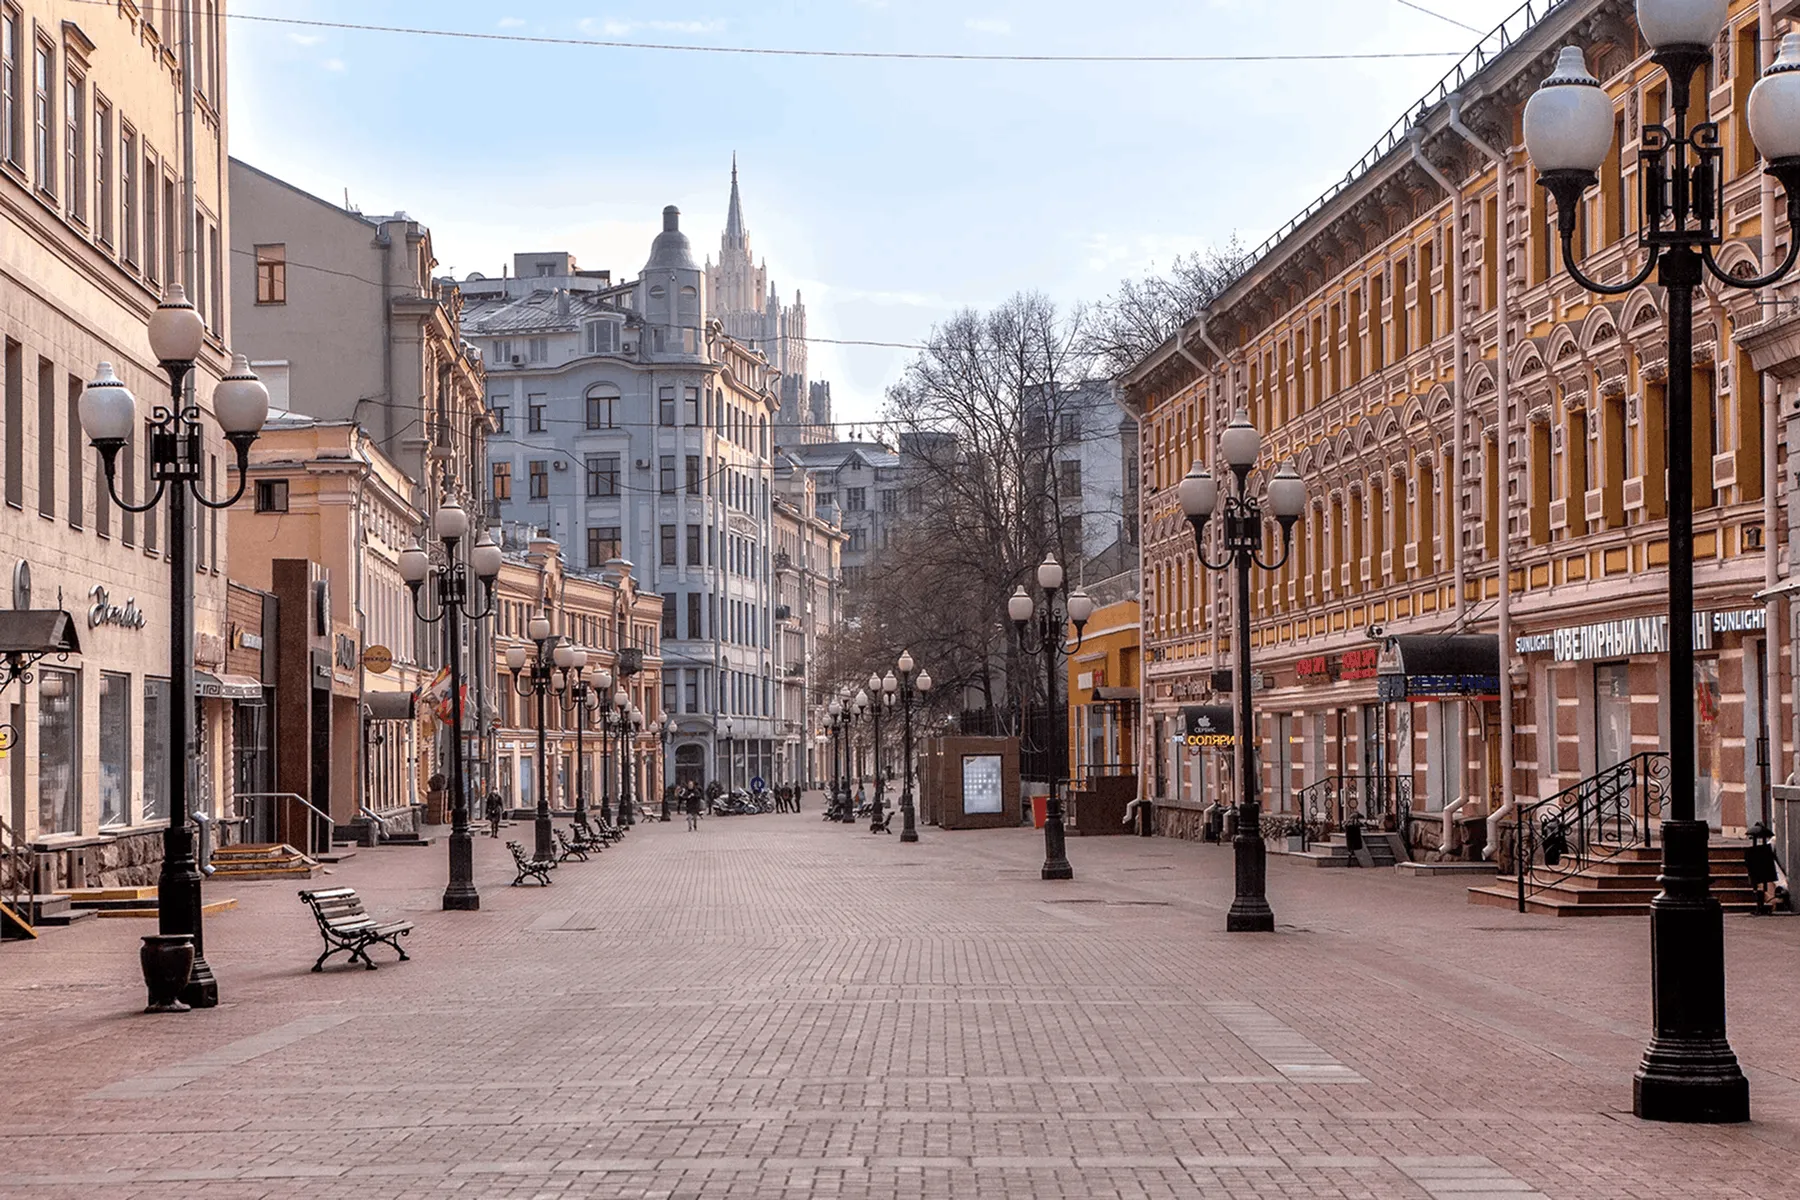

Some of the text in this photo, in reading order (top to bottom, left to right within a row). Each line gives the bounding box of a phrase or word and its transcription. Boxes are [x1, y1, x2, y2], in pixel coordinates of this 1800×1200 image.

[1638, 611, 1707, 653] МАГН
[1713, 608, 1767, 632] SUNLIGHT
[1515, 634, 1551, 653] SUNLIGHT
